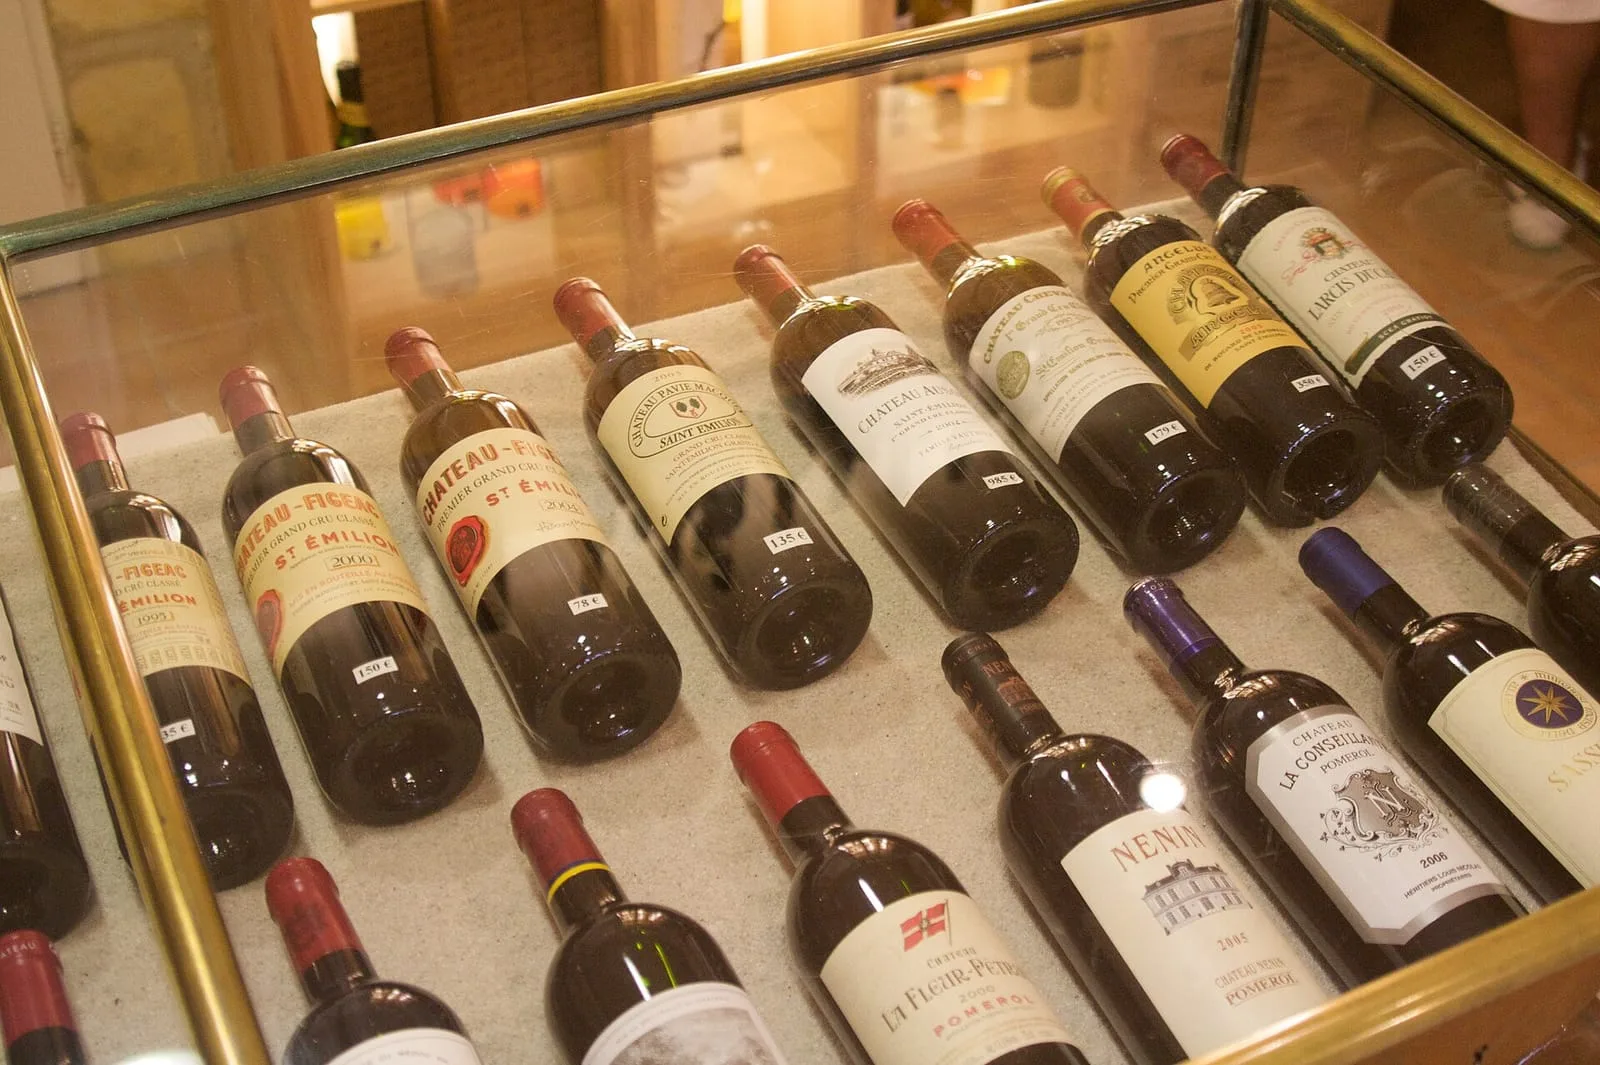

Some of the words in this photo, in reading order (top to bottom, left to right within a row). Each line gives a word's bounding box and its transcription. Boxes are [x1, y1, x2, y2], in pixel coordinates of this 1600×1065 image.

[1307, 278, 1356, 320] LARCIS
[1407, 355, 1429, 373] 150
[1297, 377, 1315, 389] 350
[632, 395, 659, 449] CHATEAU
[658, 383, 691, 400] PAVIE
[857, 386, 921, 435] CHATEAU
[659, 428, 695, 450] SAINT
[1151, 425, 1170, 440] 179
[987, 474, 1008, 486] 985
[436, 486, 473, 533] PREMIER
[473, 464, 517, 489] GRAND
[269, 522, 307, 552] GRAND
[308, 514, 335, 527] CRU
[769, 532, 796, 549] 135
[797, 531, 809, 541] €
[332, 554, 374, 570] 2000
[572, 597, 589, 610] 78
[358, 664, 381, 679] 150
[1292, 720, 1354, 747] CHATEAU
[1319, 748, 1375, 775] POMEROL
[1279, 771, 1299, 791] LA
[1110, 824, 1207, 873] NENIN
[1419, 851, 1448, 869] 2006
[1216, 931, 1249, 952] 2005
[1213, 964, 1255, 989] CHATEAU
[1253, 956, 1286, 972] NENIN
[958, 984, 997, 1003] 2000
[1225, 972, 1299, 1007] POMEROL
[933, 993, 1034, 1038] POMEROL
